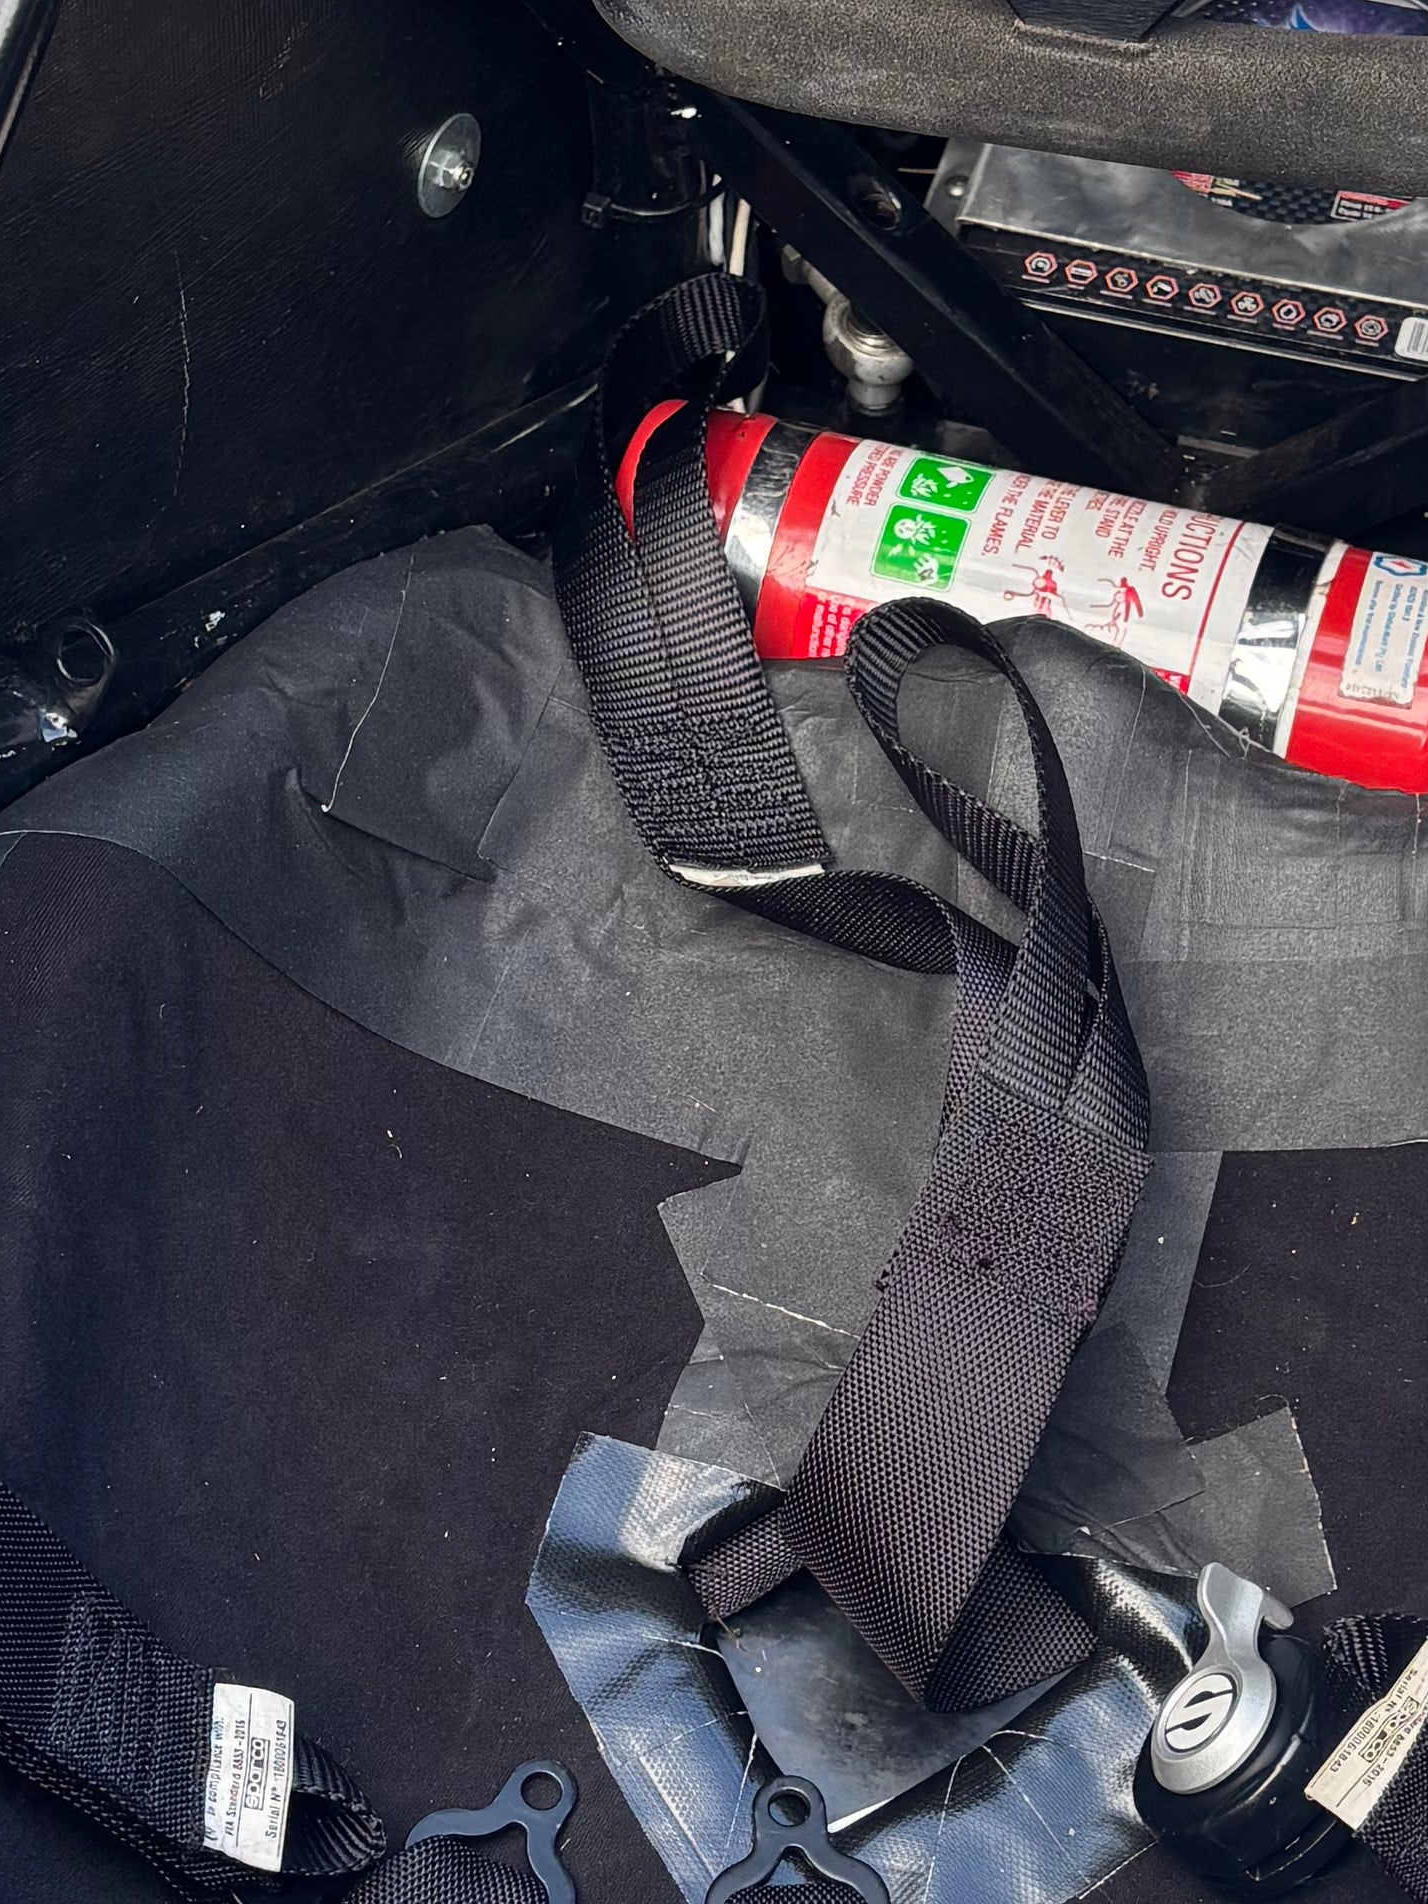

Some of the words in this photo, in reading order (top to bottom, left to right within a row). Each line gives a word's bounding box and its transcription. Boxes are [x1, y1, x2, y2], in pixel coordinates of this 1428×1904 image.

[847, 460, 876, 506] PRESSURE
[863, 467, 890, 506] POWDER
[1046, 495, 1069, 523] LEVER
[1093, 507, 1119, 538] STAND
[981, 506, 1012, 558] FLAMES.
[1040, 523, 1059, 540] TO
[1108, 533, 1128, 558] THE
[1160, 512, 1221, 603] UCTIONS
[1392, 1667, 1418, 1698] Serial
[226, 1773, 241, 1817] Standard
[264, 1806, 279, 1838] Serial
